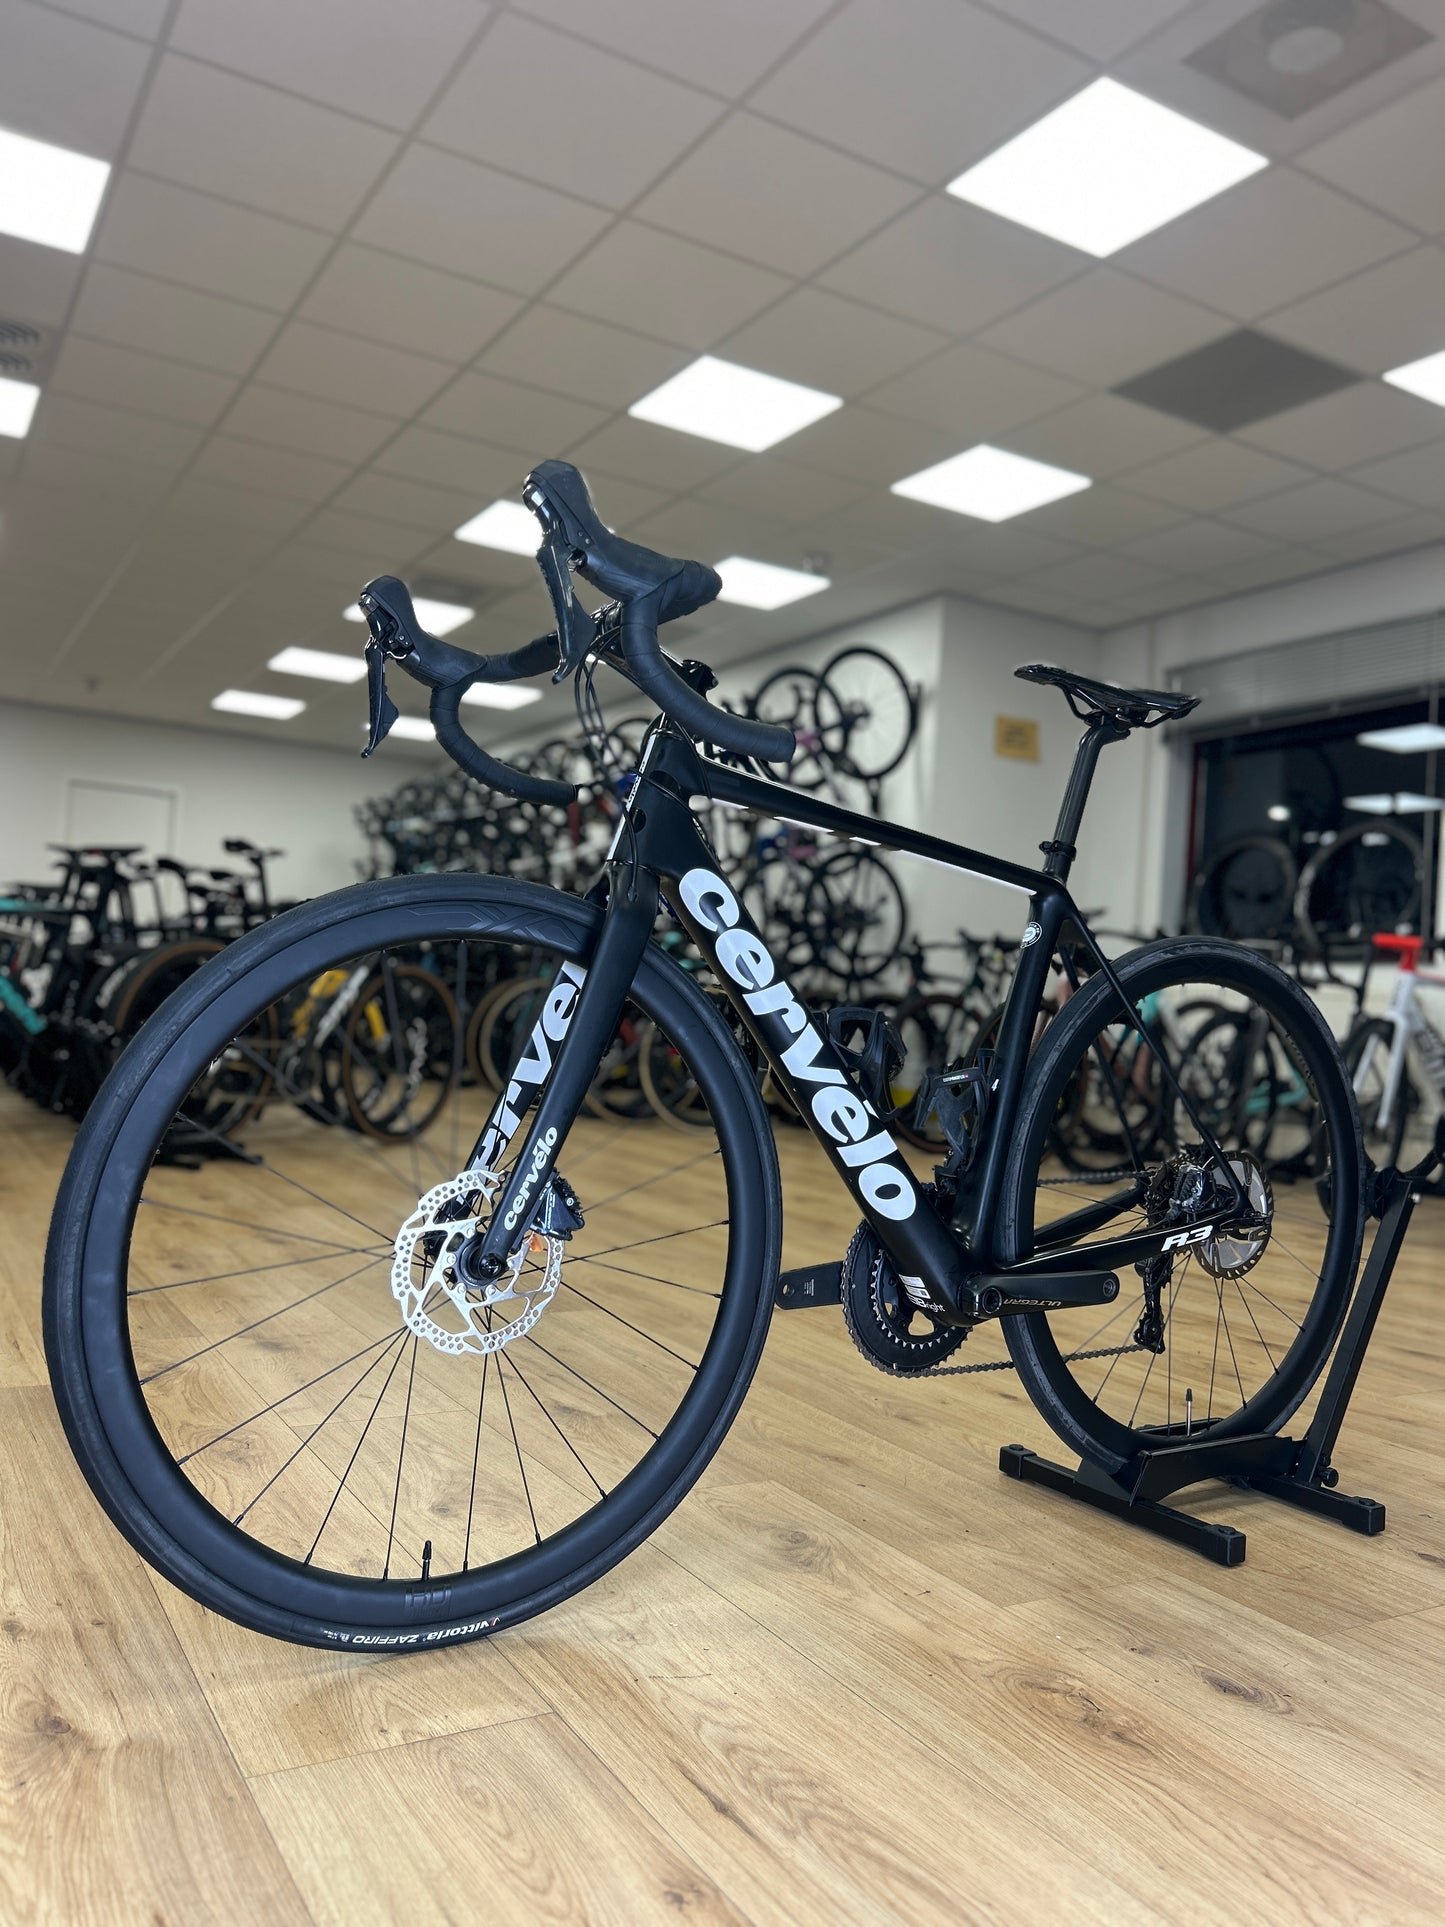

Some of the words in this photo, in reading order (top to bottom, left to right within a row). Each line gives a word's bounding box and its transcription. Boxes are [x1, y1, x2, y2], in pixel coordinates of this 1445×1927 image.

[504, 1127, 558, 1231] cervélo
[1161, 1225, 1214, 1252] R3
[1003, 1298, 1062, 1308] ULTEGRA
[352, 1634, 420, 1645] ZAFFIRO
